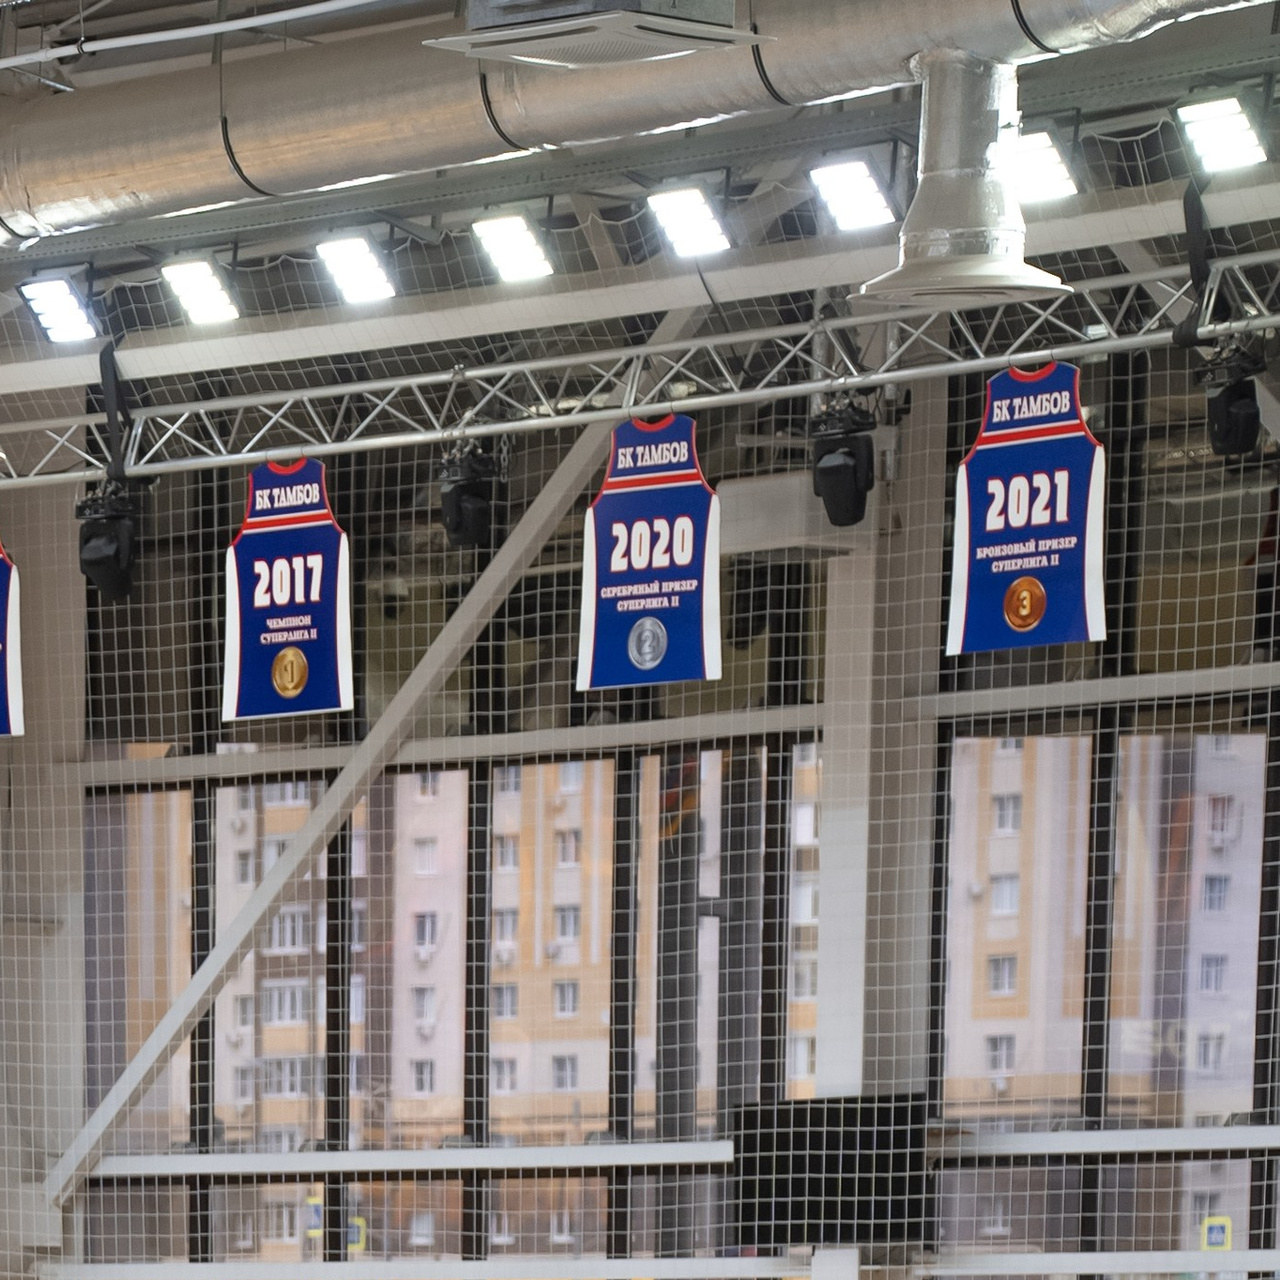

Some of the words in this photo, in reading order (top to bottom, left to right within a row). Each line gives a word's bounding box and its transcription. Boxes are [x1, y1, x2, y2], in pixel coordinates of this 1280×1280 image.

[992, 399, 1011, 423] БК
[1012, 391, 1071, 420] ТАМБОВ
[617, 448, 634, 470] БК
[635, 441, 689, 467] ТАМБОВ
[255, 489, 271, 511] БК
[272, 483, 320, 508] ТАМБОВ
[985, 469, 1069, 532] 2021
[610, 516, 694, 573] 2020
[976, 537, 1036, 560] БРОНЗОВЫЙ
[1037, 536, 1077, 552] ПРИЗЕР
[991, 556, 1049, 573] СУПЕРЛИГА
[253, 553, 324, 608] 2017
[601, 580, 660, 598] СЕРЕБРЯНЫЙ
[661, 579, 698, 593] ПРИЗЕР
[616, 597, 670, 612] СУПЕРЛИГА
[266, 615, 311, 630] ЧЕМПИОН
[260, 629, 310, 645] СУПЕРЛИГА
